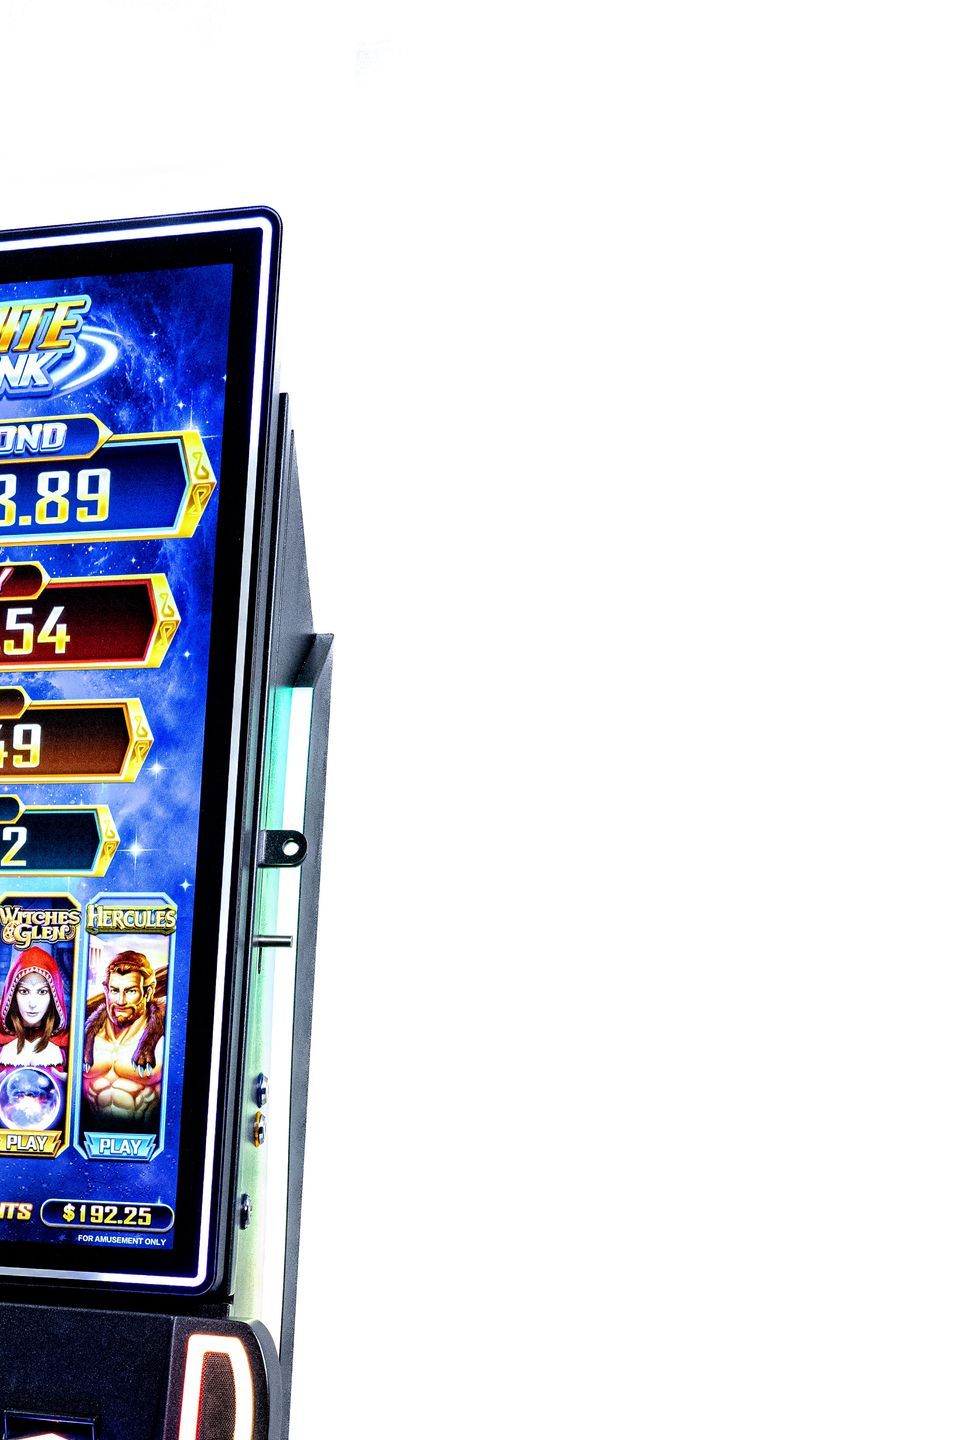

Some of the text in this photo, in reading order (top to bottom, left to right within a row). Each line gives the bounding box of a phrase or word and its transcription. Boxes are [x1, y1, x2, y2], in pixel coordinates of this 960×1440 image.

[87, 904, 176, 930] HERCULES
[6, 1134, 48, 1152] PLAY
[99, 1138, 142, 1156] PLAY
[62, 1203, 152, 1226] $192.25
[78, 1234, 167, 1246] FOR AMUSEMENT ONLY
